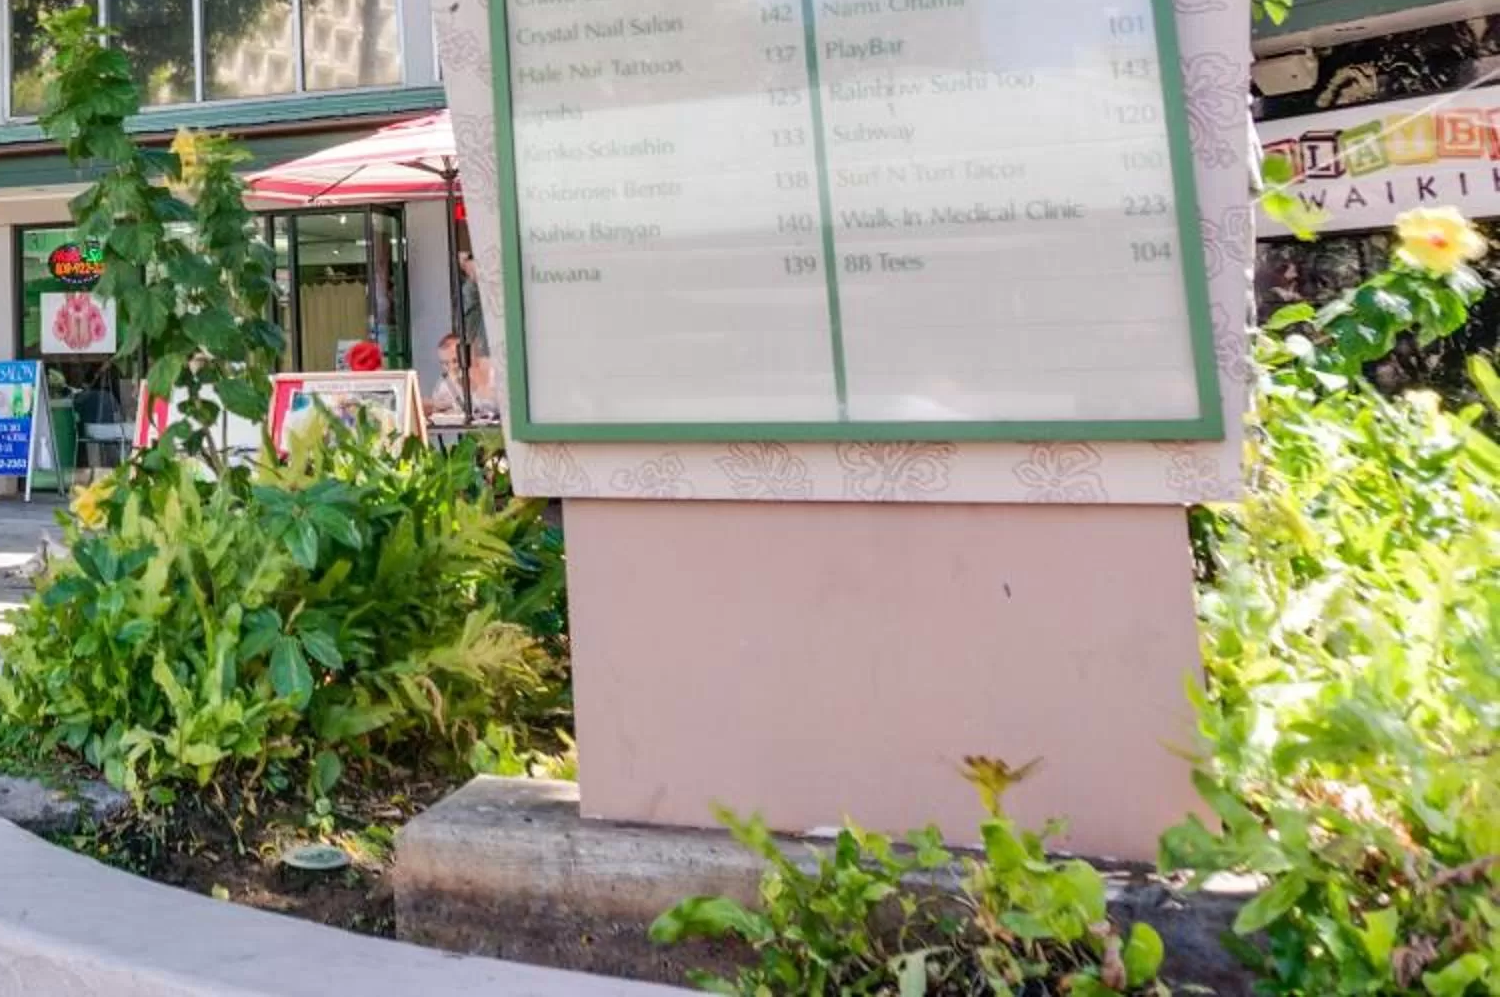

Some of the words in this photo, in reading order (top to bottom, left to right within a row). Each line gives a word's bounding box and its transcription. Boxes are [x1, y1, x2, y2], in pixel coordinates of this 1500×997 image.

[760, 4, 793, 23] 142
[516, 24, 579, 46] Crystal
[585, 19, 624, 39] Nail
[630, 14, 685, 36] Salon
[1109, 14, 1145, 37] 101
[826, 37, 905, 60] PlayBar
[611, 58, 685, 78] Tattoos
[931, 201, 1017, 227] Medical
[1025, 198, 1088, 221] Clinic
[1124, 195, 1167, 217] 223
[878, 251, 926, 273] Tees
[1130, 242, 1172, 264] 104
[784, 254, 817, 276] 139
